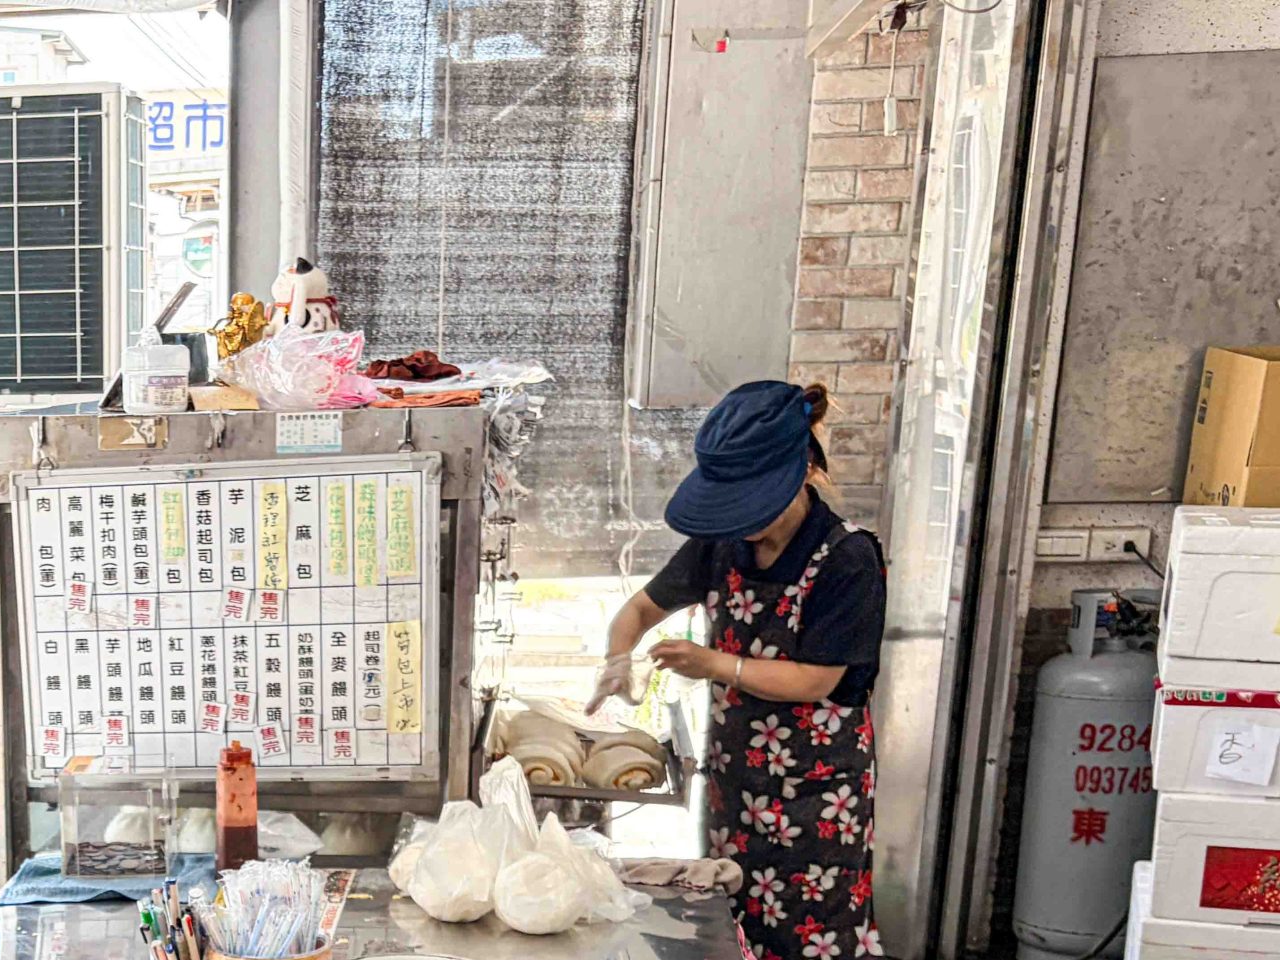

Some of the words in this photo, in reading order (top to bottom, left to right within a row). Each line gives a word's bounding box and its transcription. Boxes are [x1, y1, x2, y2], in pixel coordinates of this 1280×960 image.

[196, 489, 214, 583] 香菇起司包
[295, 485, 312, 580] 芝麻包
[69, 582, 87, 612] 售完
[133, 597, 150, 626] 售完
[224, 589, 245, 619] 售完
[260, 591, 279, 620] 售完
[45, 640, 63, 726] 白饅頭
[74, 638, 94, 725] 黑饅頭
[136, 637, 156, 725] 地瓜饅頭
[168, 637, 187, 725] 紅豆饅頭
[264, 633, 282, 722] 五穀饅頭
[330, 631, 348, 721] 全麥饅頭
[202, 703, 221, 732] 售完
[231, 693, 249, 721] 售完
[43, 729, 60, 755] 售完
[107, 719, 124, 745] 售完
[260, 726, 282, 755] 售完
[296, 716, 315, 744] 售完
[334, 730, 352, 758] 售完
[1070, 808, 1110, 846] 東
